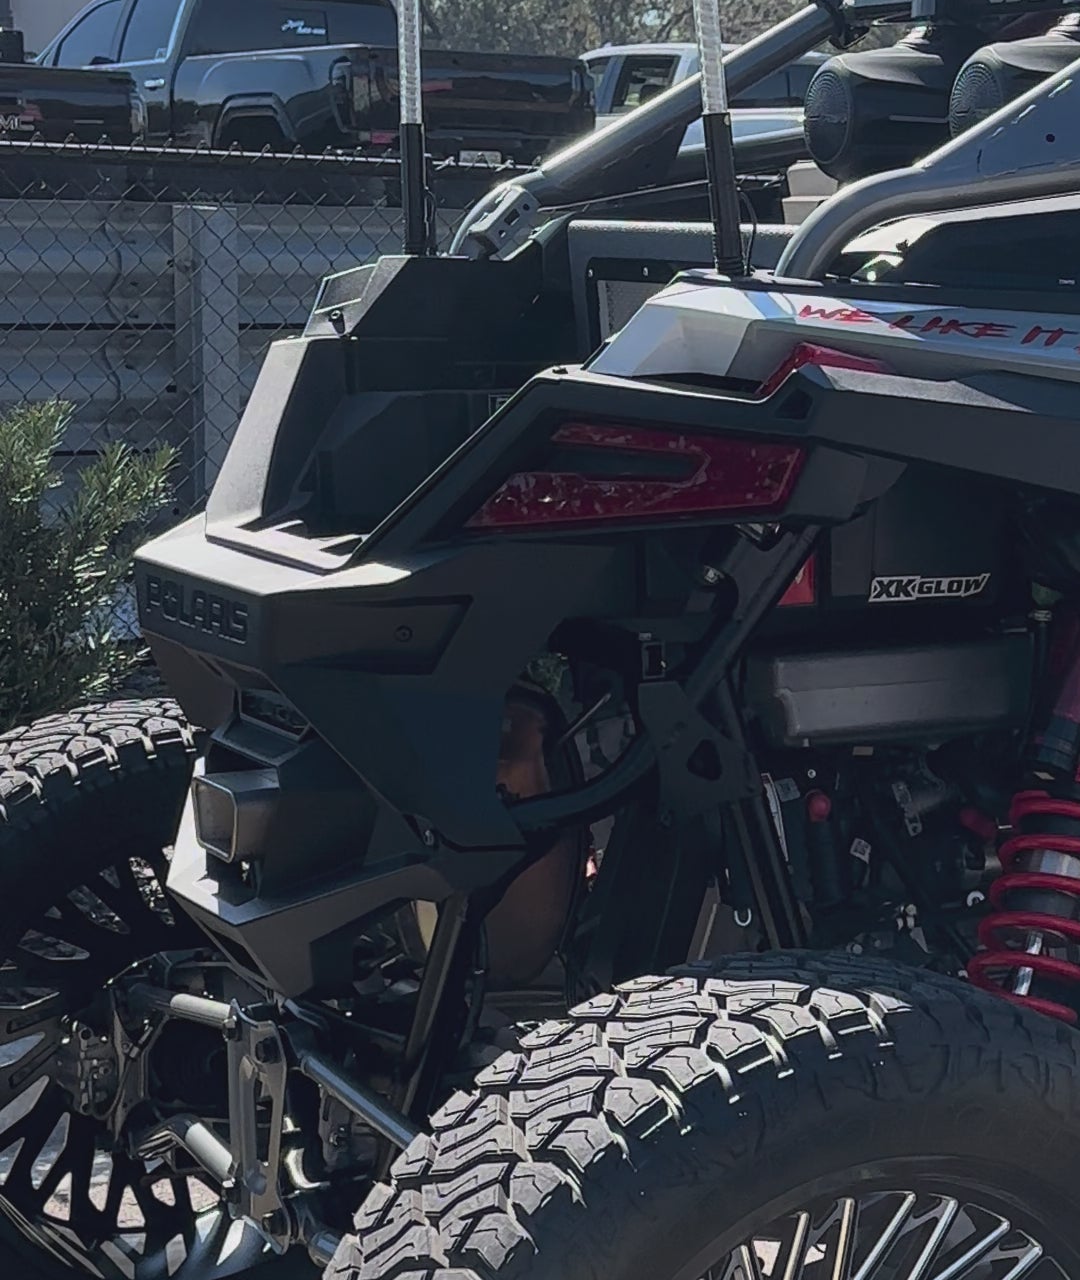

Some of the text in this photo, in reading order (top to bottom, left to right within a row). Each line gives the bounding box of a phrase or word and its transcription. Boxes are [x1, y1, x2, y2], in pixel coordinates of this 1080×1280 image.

[799, 305, 874, 324] WE
[888, 315, 1017, 338] LIKE
[1020, 325, 1079, 346] IT
[146, 575, 248, 645] POLARIS
